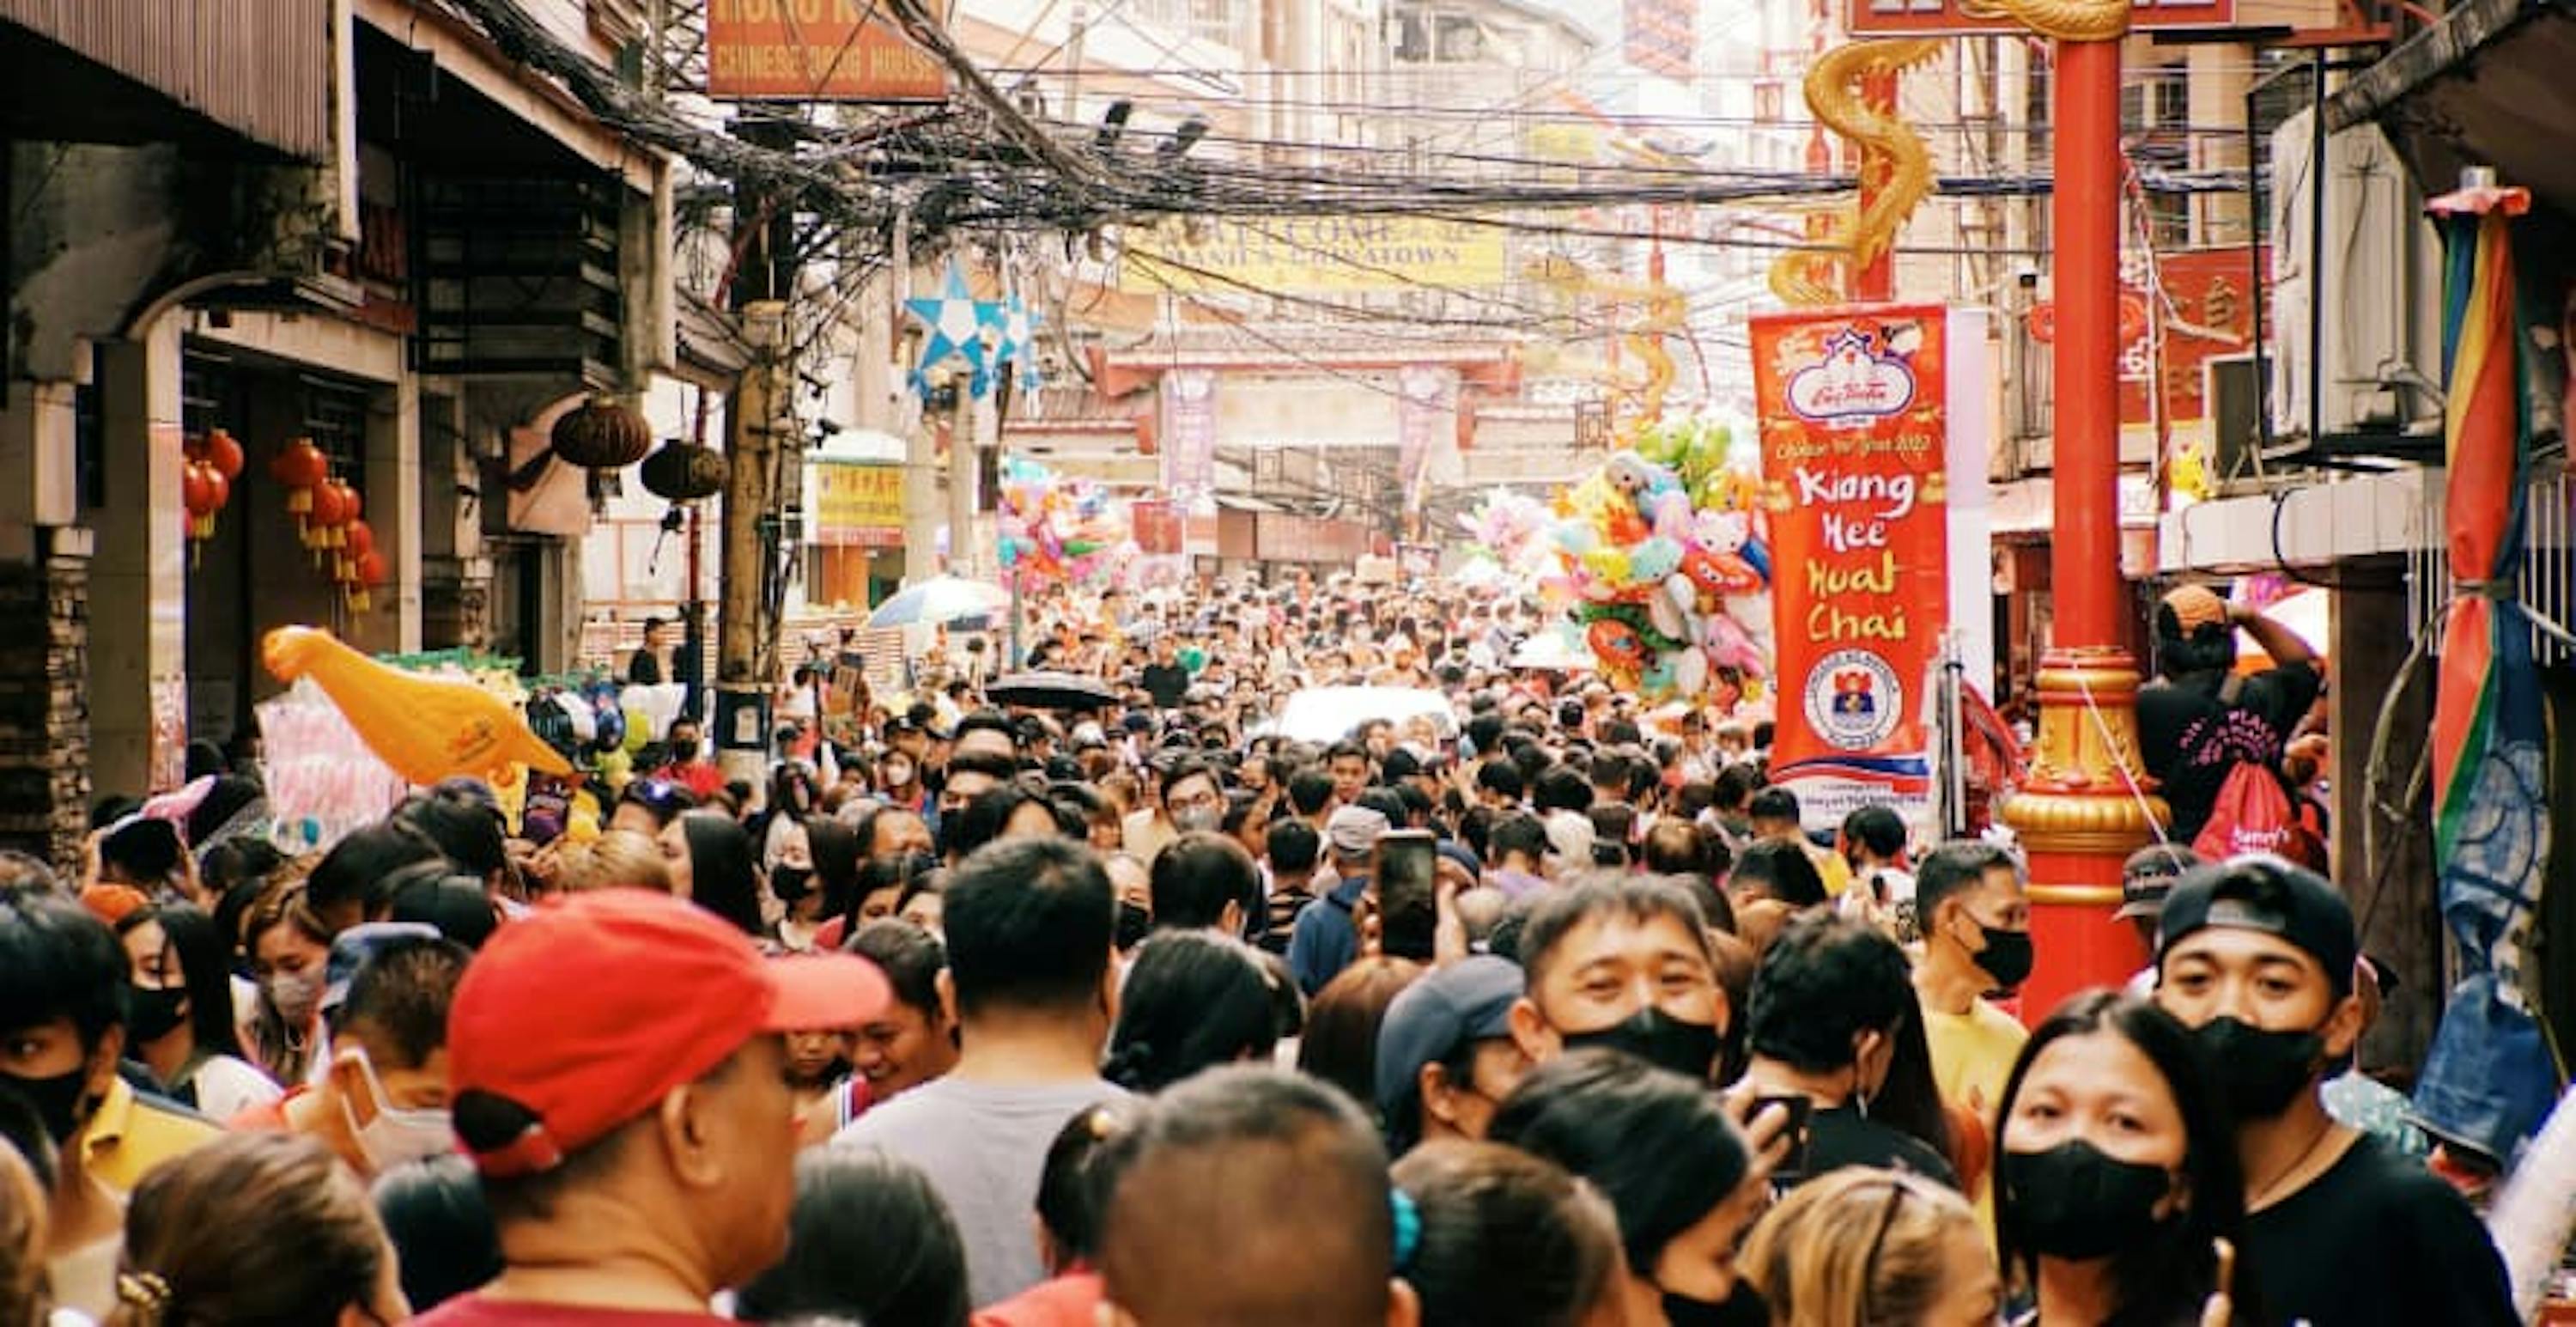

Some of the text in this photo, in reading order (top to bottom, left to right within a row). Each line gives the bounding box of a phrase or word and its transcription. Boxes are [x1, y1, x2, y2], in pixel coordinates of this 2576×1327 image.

[716, 45, 805, 78] CHINESE
[1821, 511, 1888, 553] Hee
[1807, 549, 1896, 600] Huat
[1807, 602, 1906, 642] Chai
